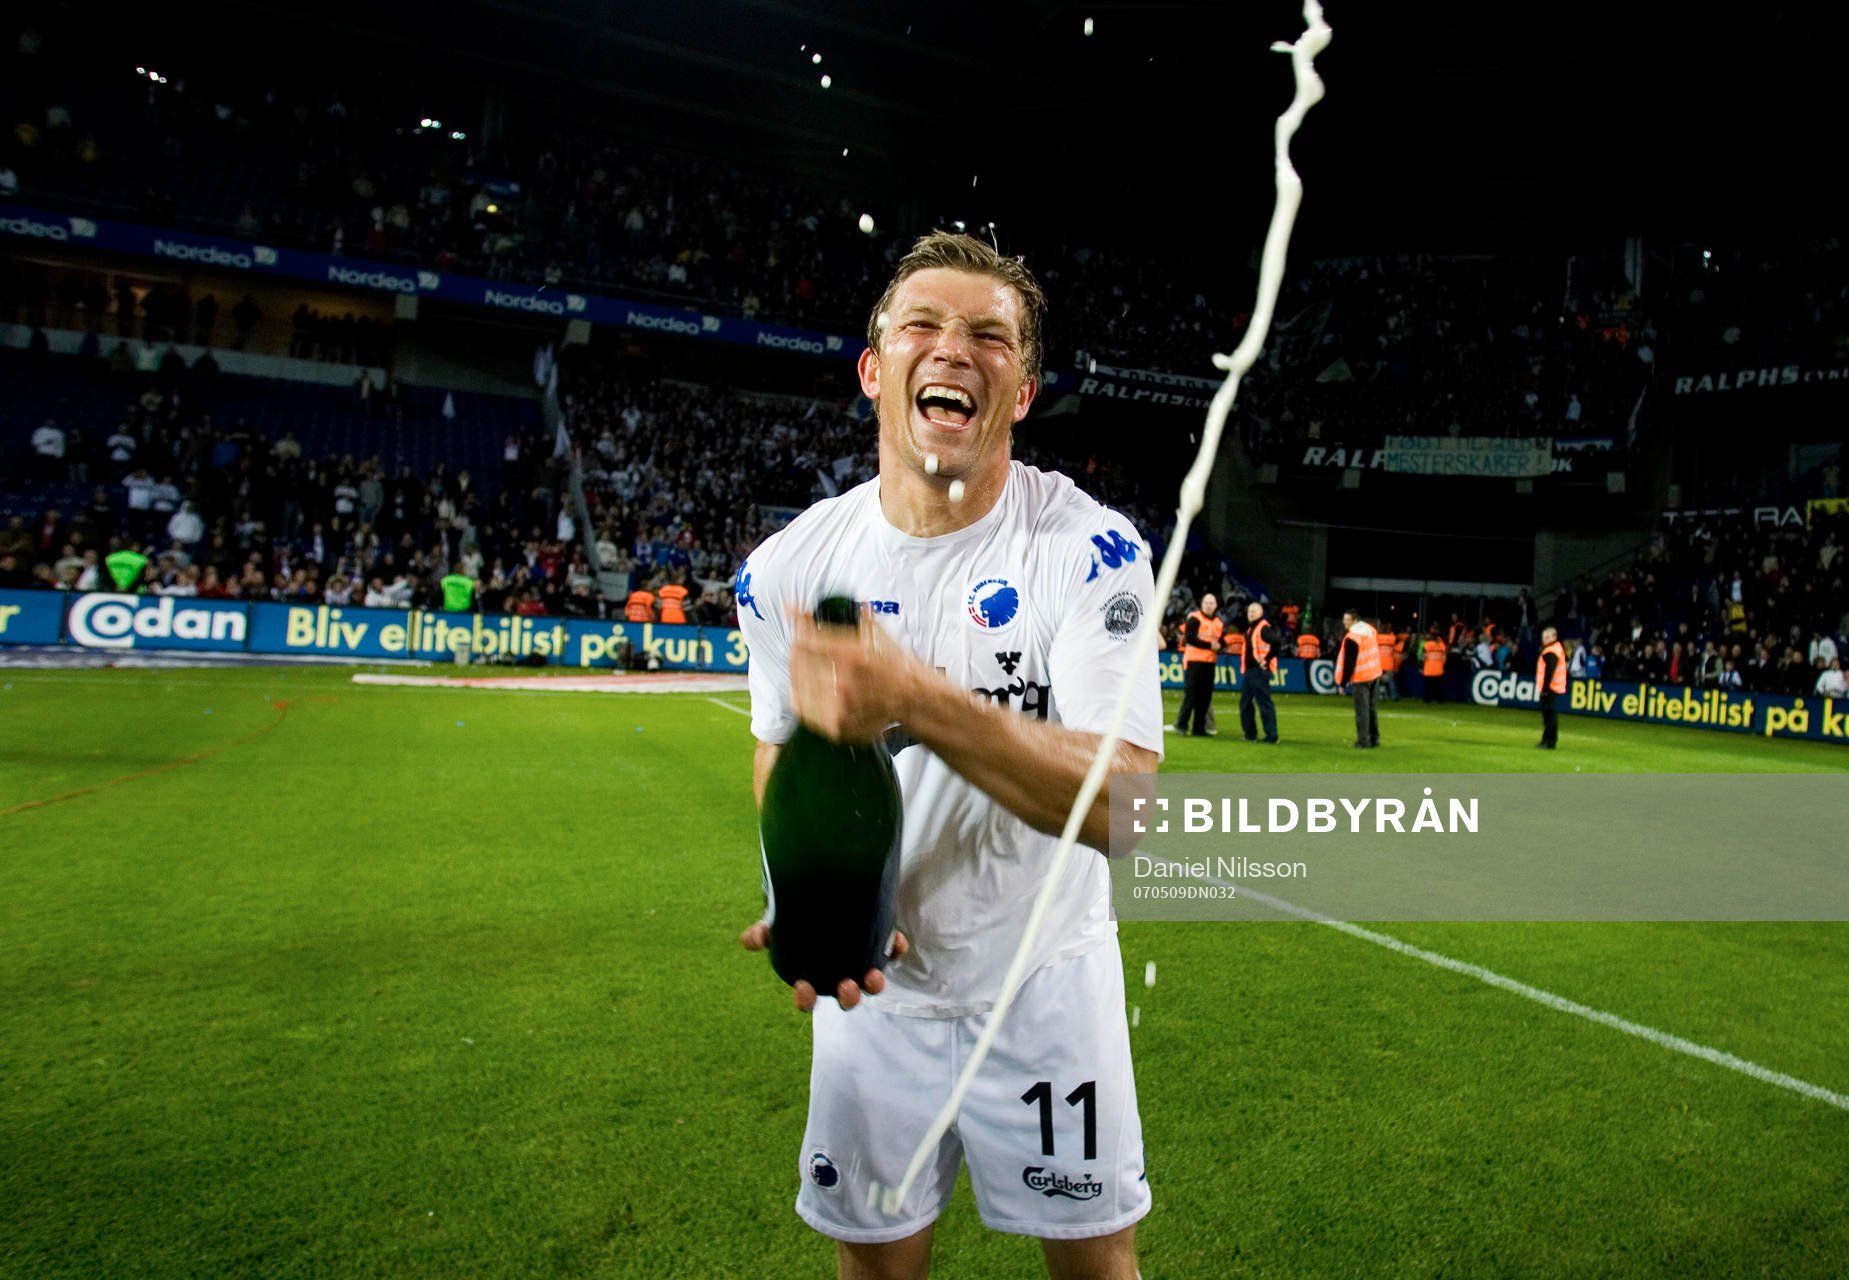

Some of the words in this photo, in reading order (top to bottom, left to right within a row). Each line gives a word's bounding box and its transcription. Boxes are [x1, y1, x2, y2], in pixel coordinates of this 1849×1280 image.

[0, 217, 68, 241] rdea
[153, 238, 253, 269] Nordea
[327, 264, 417, 294] Nordea
[483, 288, 566, 317] Nordea
[626, 310, 700, 337] Nordea
[757, 331, 825, 354] Nordea
[1674, 364, 1801, 396] RALPHS
[69, 592, 247, 648] Codan
[286, 604, 369, 650] Bliv
[379, 609, 570, 657] elitebilist
[580, 624, 630, 667] på
[643, 622, 713, 664] kun
[725, 629, 749, 666] 3
[1571, 679, 1617, 712] Bliv
[1621, 683, 1754, 728] elitebilist
[1765, 698, 1810, 737] på
[1020, 1080, 1097, 1161] 11
[1022, 1166, 1103, 1200] Carlsberg
